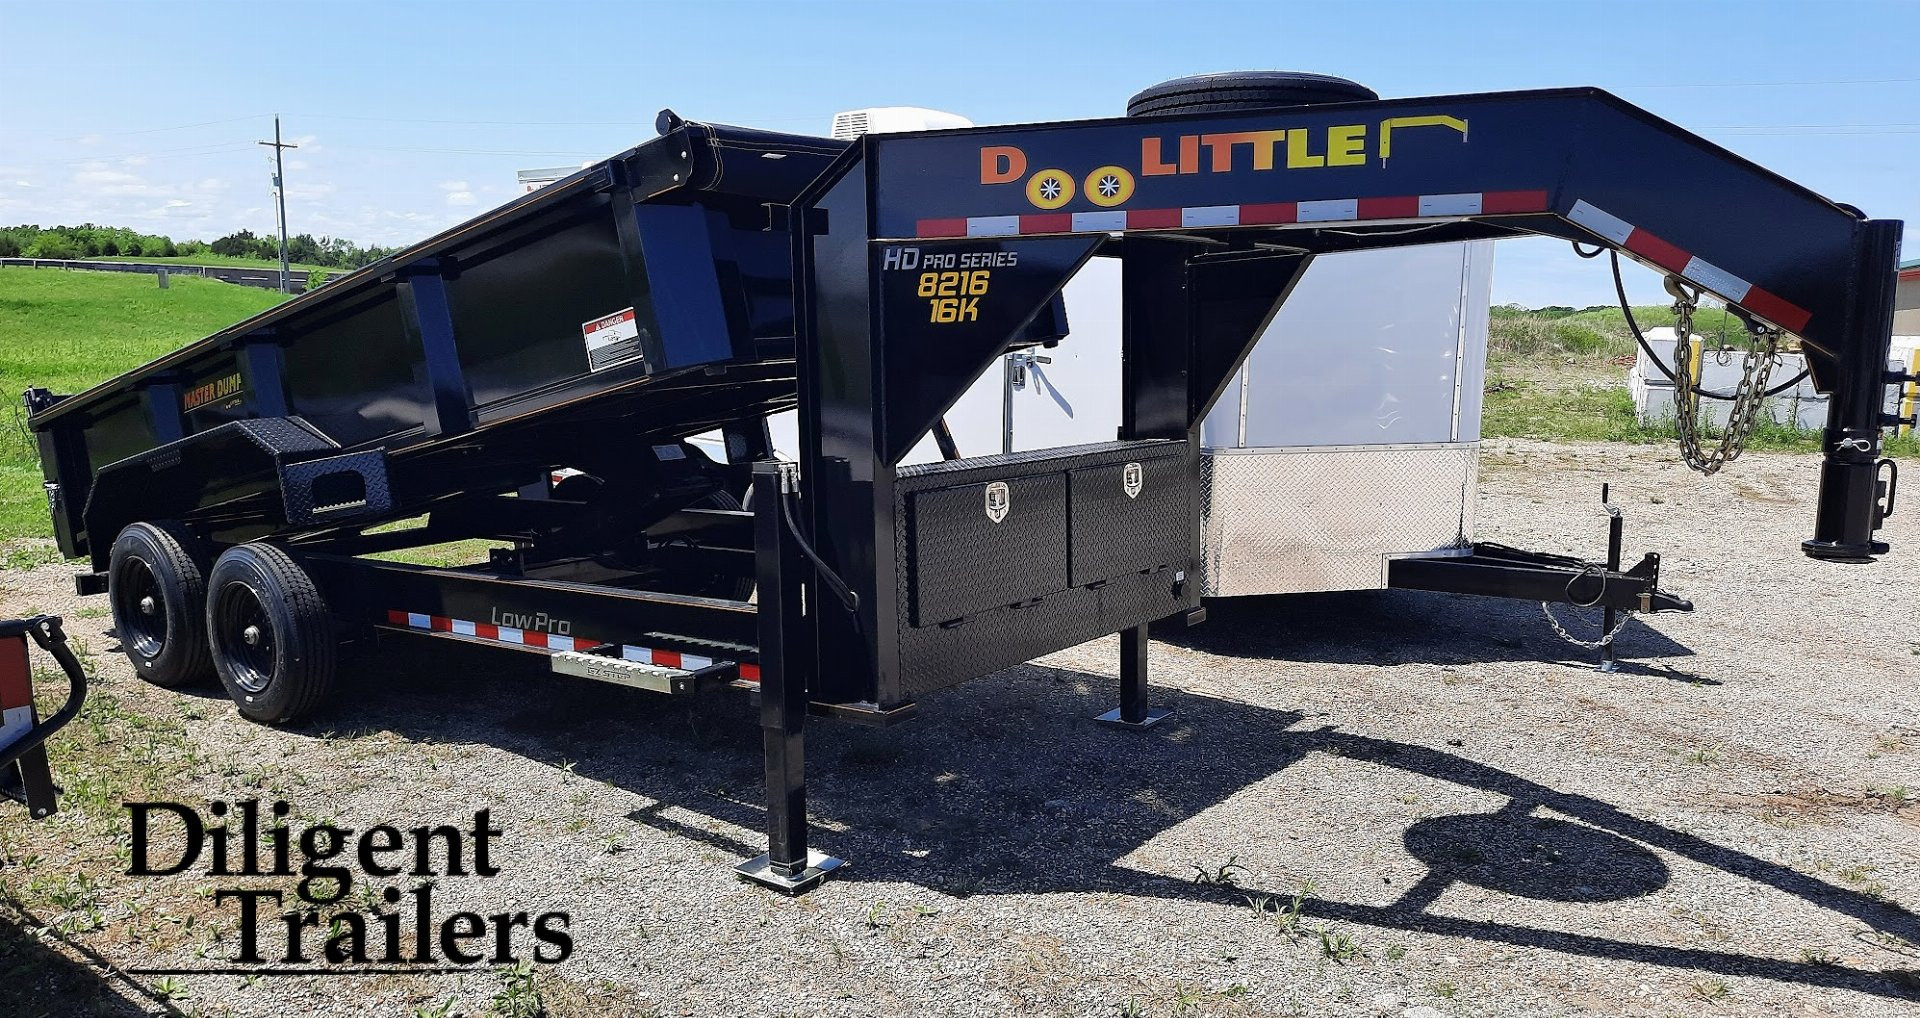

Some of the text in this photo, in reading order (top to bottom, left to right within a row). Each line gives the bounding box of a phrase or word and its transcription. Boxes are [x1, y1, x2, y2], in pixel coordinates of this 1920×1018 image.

[883, 247, 1018, 270] HD PRO SERIES
[918, 270, 990, 297] 8216
[601, 315, 624, 329] DANGER
[930, 297, 980, 323] 16K
[184, 383, 216, 410] MASTER
